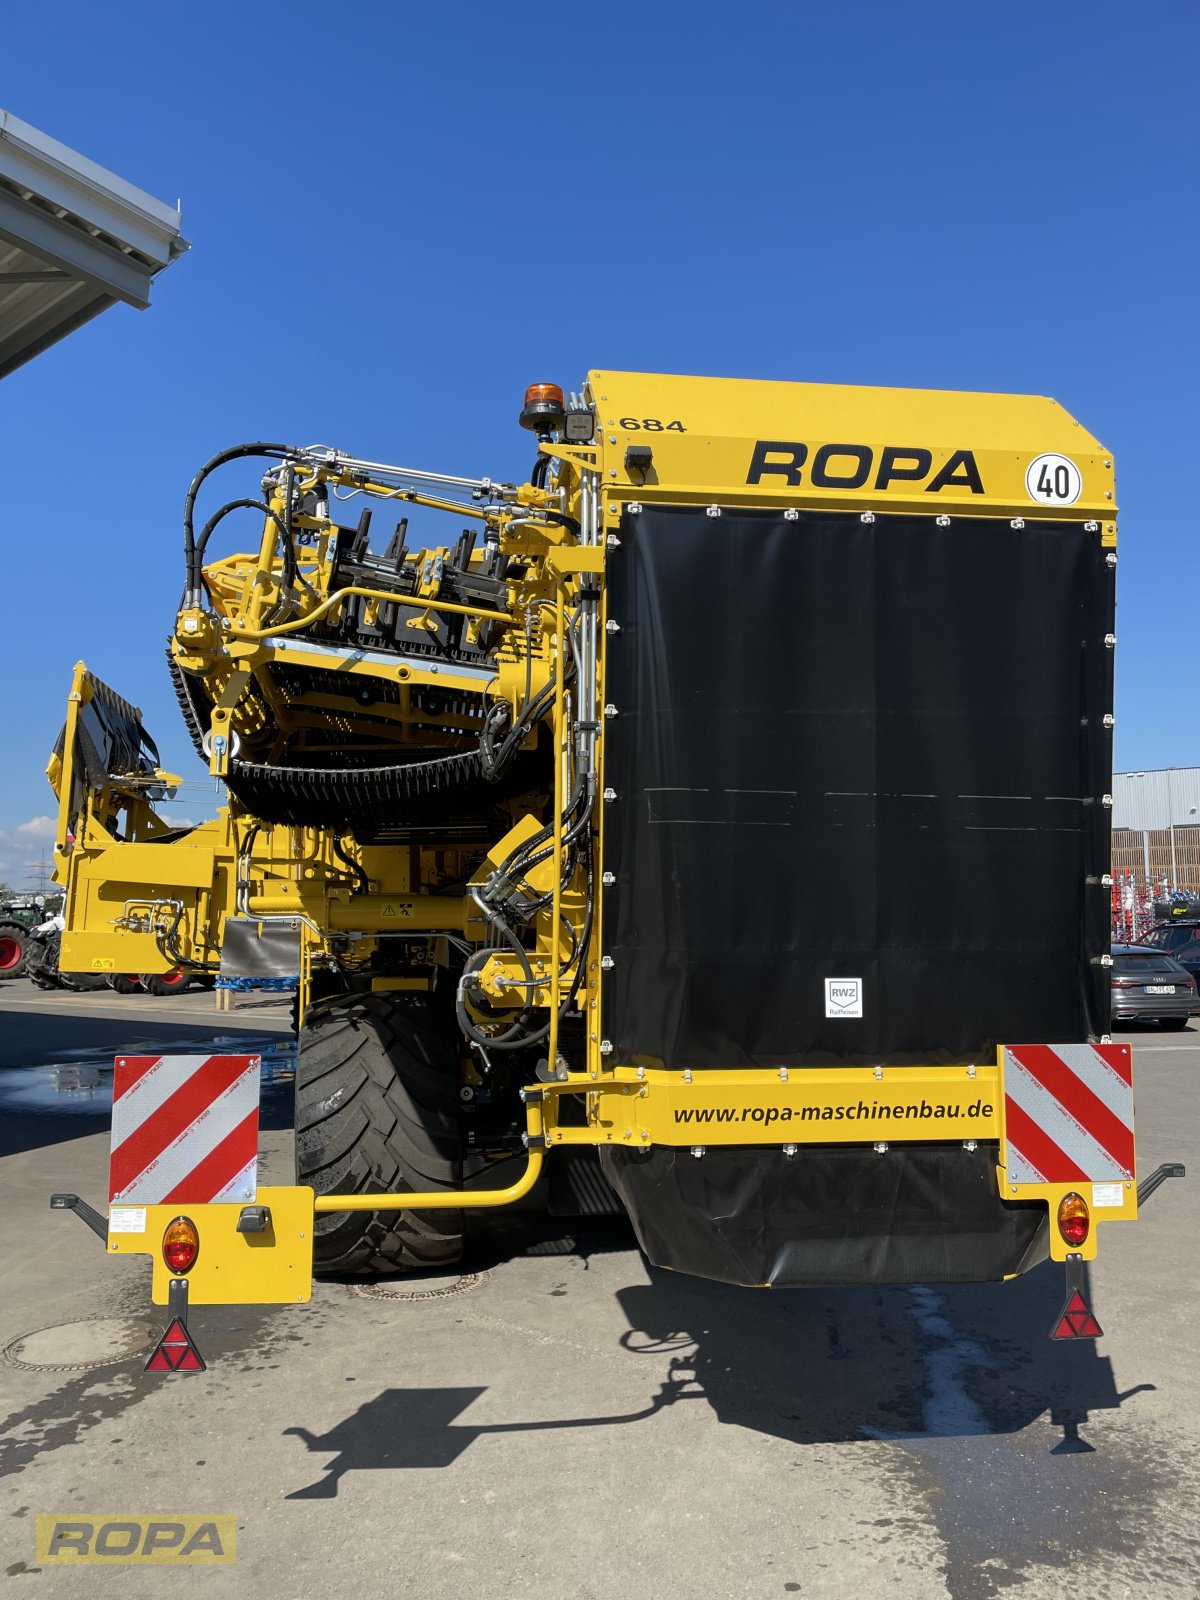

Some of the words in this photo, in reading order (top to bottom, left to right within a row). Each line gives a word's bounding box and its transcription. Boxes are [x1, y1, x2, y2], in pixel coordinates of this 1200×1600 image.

[619, 417, 687, 432] 684
[745, 440, 985, 494] ROPA
[1036, 464, 1070, 499] 40
[832, 988, 855, 997] RWZ
[829, 1008, 859, 1016] Raiffeisen
[149, 1061, 163, 1075] GEKA
[674, 1099, 993, 1126] www.ropa-maschinenbau.de
